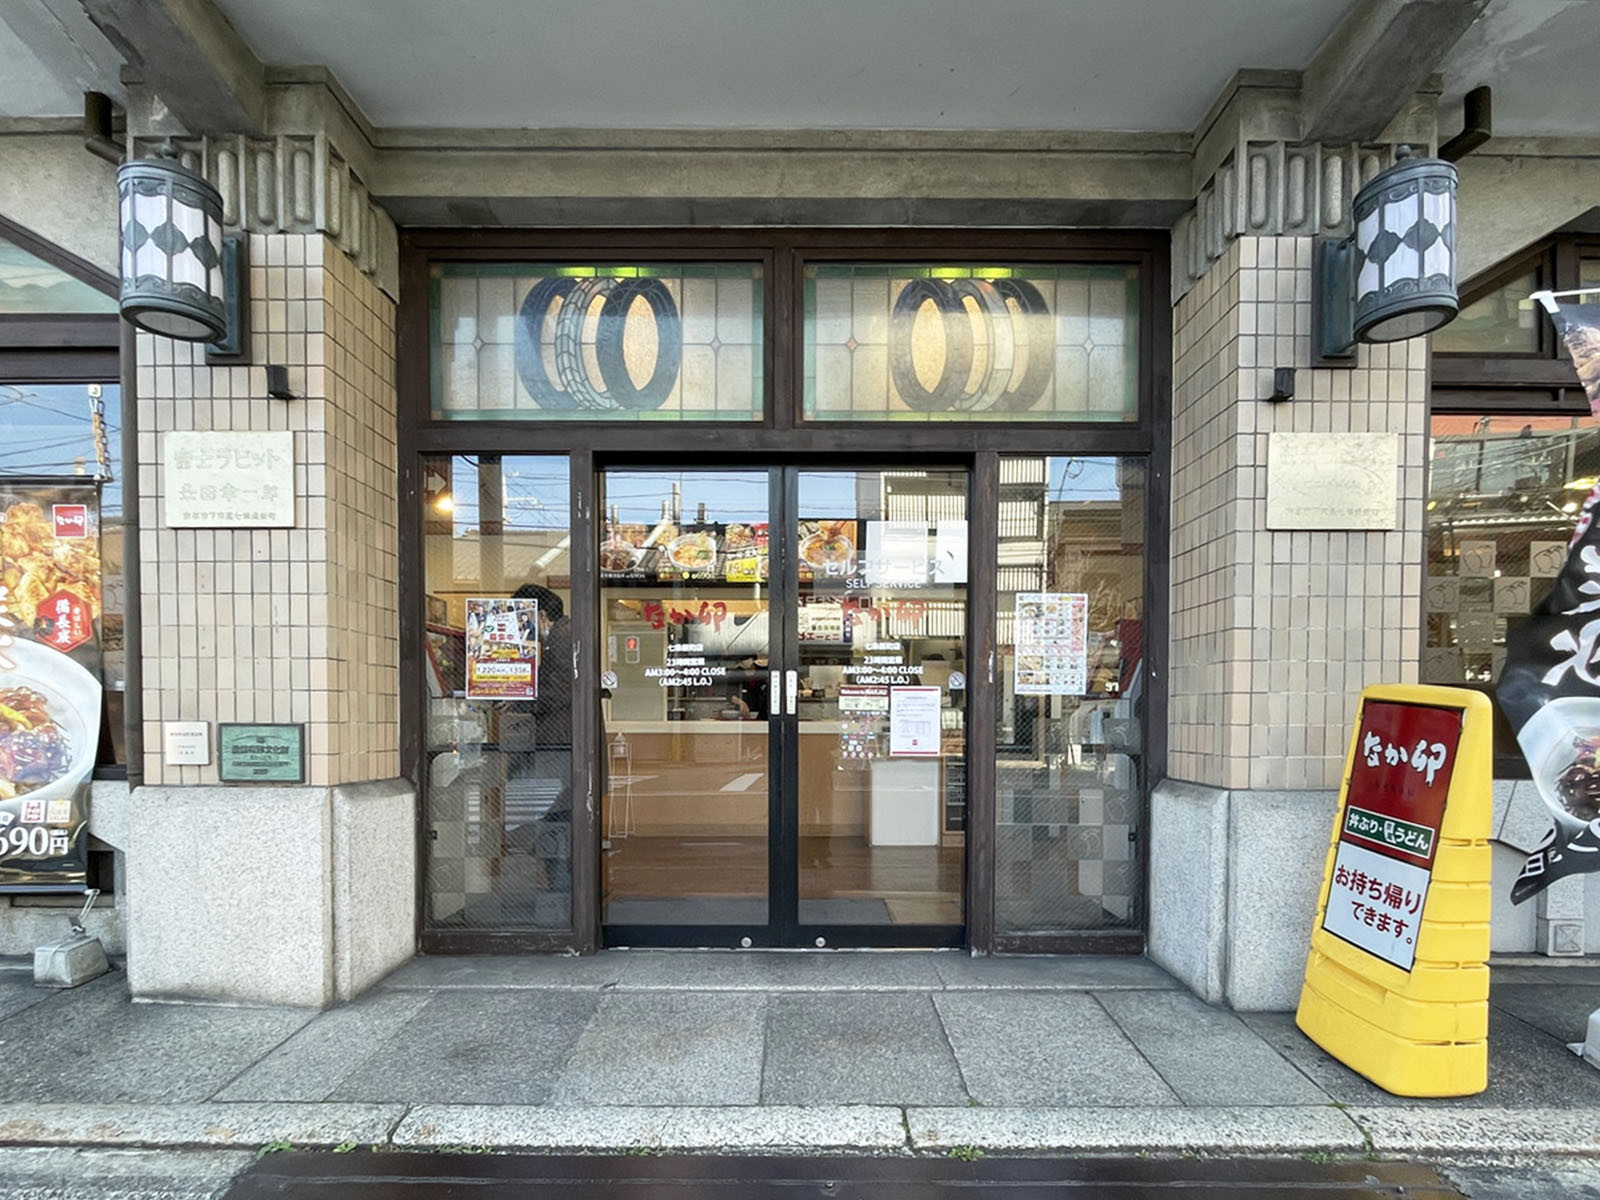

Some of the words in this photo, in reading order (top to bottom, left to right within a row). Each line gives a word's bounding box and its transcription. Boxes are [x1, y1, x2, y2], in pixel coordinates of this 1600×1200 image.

[824, 558, 945, 576] セルフサービス
[846, 578, 872, 589] SELF
[877, 578, 922, 589] SERVICE
[644, 601, 727, 632] なか卯
[701, 667, 726, 676] CLOSE
[898, 665, 924, 675] CLOSE
[1363, 730, 1447, 787] なか卯
[1335, 865, 1421, 915] お持ち帰り
[1351, 901, 1413, 945] できます。
